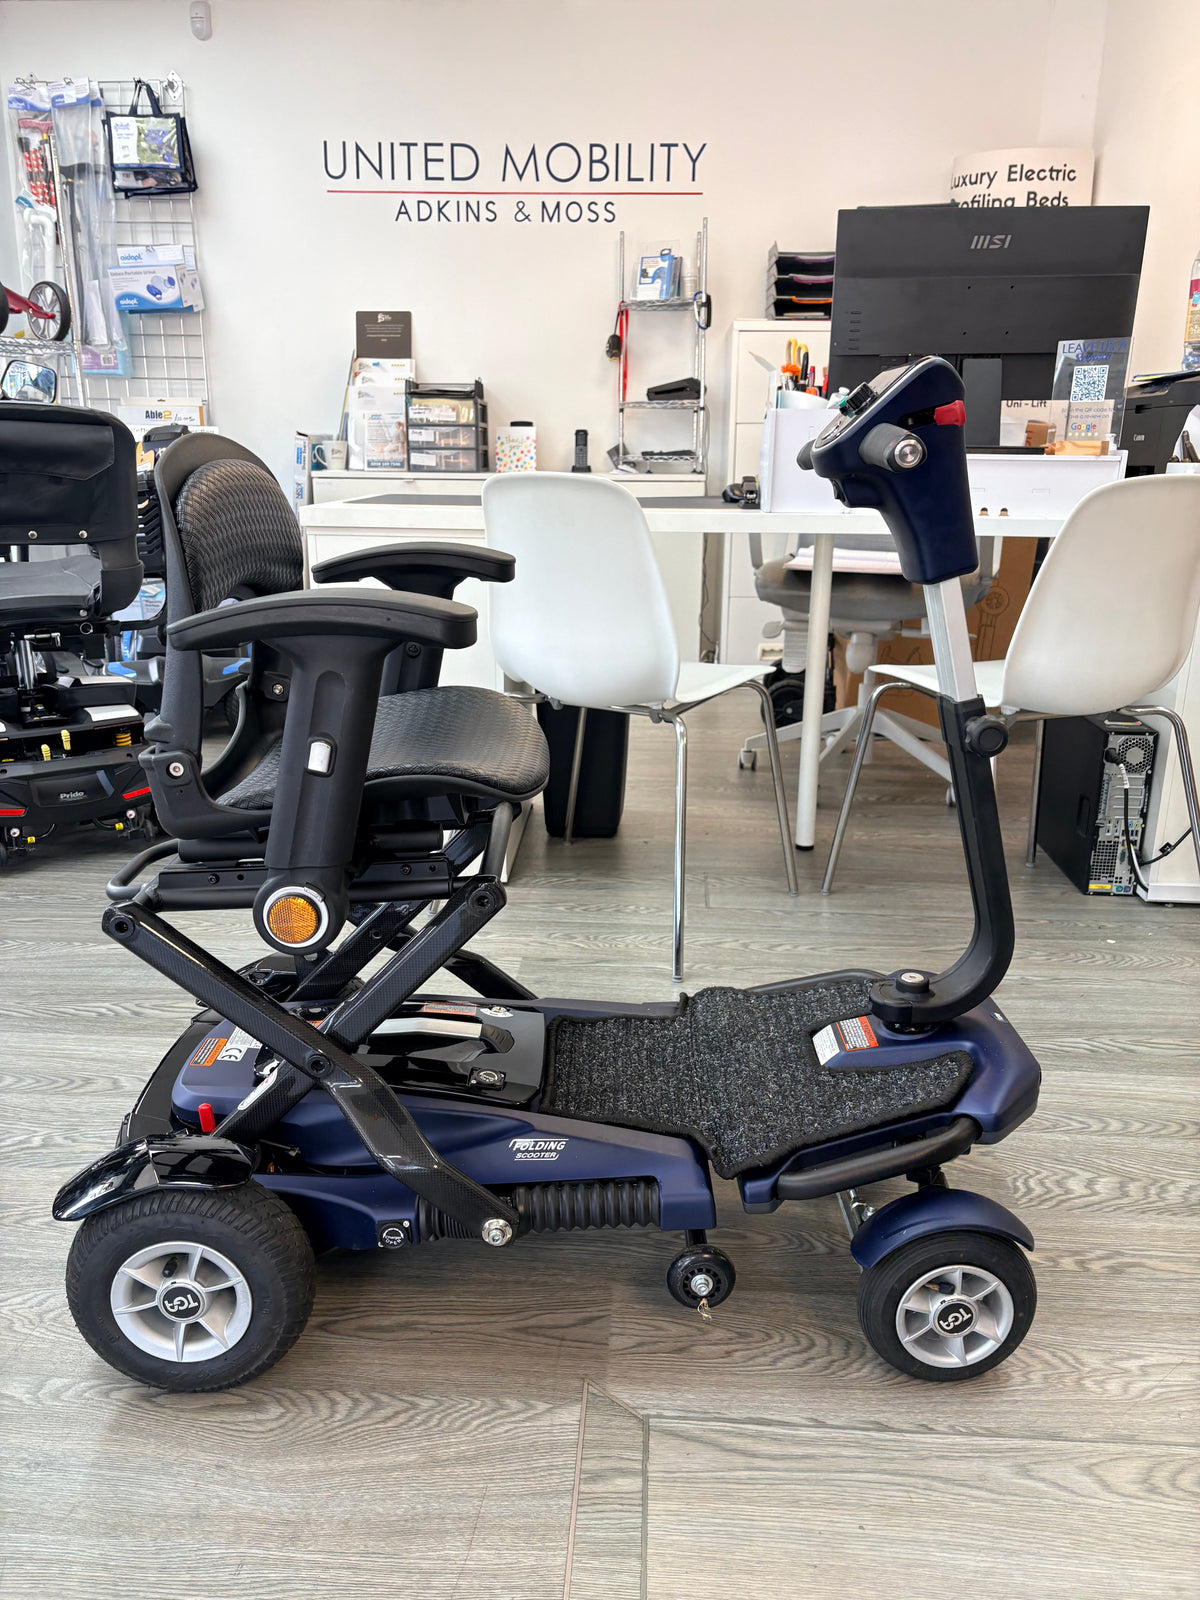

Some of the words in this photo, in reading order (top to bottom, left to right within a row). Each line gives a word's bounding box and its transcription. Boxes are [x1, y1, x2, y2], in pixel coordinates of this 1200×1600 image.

[323, 140, 480, 182] UNITED
[501, 142, 707, 183] MOBILITY
[1007, 163, 1077, 182] Electric
[1026, 190, 1069, 207] Beds
[395, 200, 498, 223] ADKINS
[513, 200, 532, 222] &
[541, 200, 617, 223] MOSS
[1062, 342, 1096, 354] LEAVE
[1100, 340, 1115, 352] US
[1118, 340, 1127, 351] A
[145, 410, 173, 420] Able2
[1070, 422, 1097, 432] Google
[59, 791, 85, 799] Pride
[512, 1140, 567, 1151] FOLDING
[515, 1151, 557, 1159] SCOOTER
[164, 1294, 199, 1313] TGA
[939, 1308, 972, 1330] TGA
